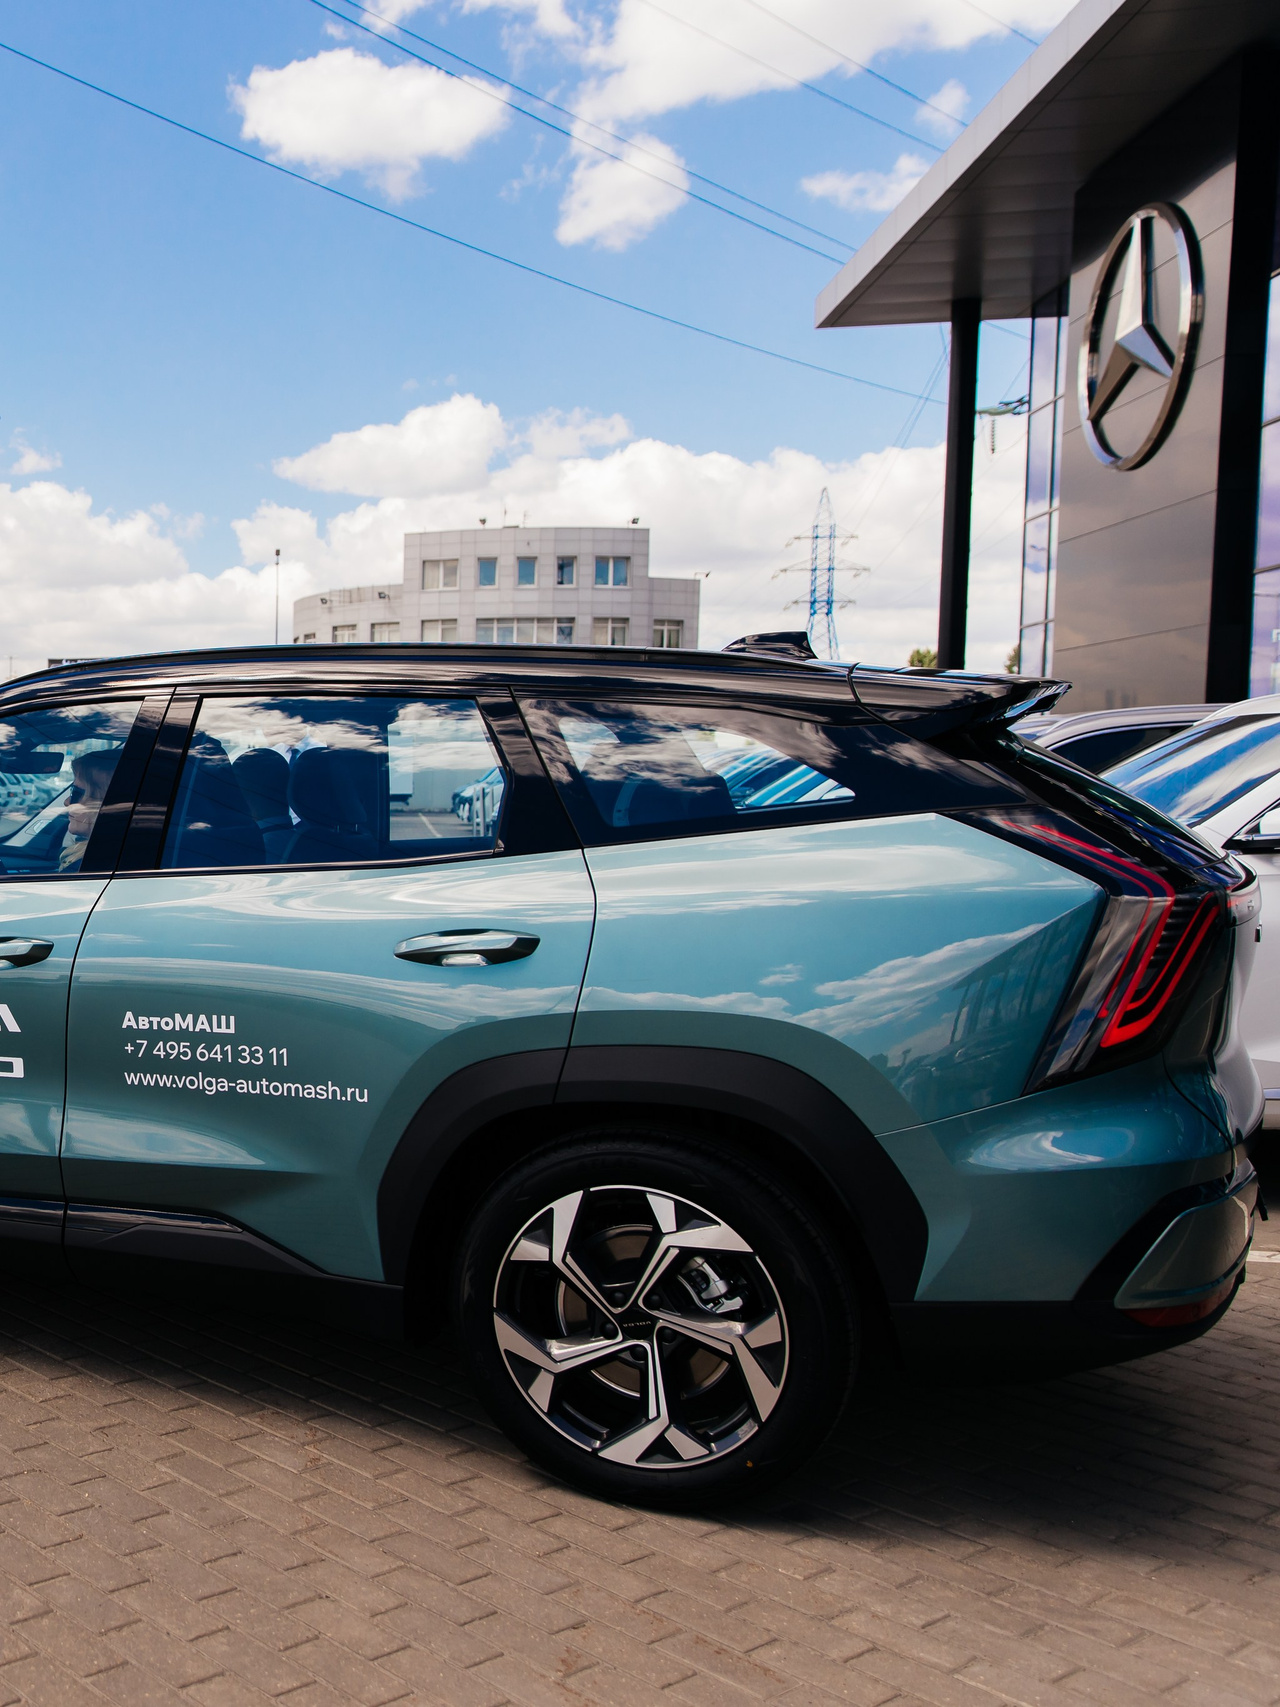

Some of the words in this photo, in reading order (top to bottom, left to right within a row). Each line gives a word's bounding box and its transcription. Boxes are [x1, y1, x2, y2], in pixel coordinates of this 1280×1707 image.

[122, 1011, 236, 1034] АвтоМАШ
[124, 1039, 148, 1058] +7
[152, 1041, 192, 1060] 495
[196, 1043, 232, 1063] 641
[237, 1045, 264, 1066] 33
[269, 1047, 289, 1066] 11
[124, 1072, 369, 1103] www.volga-automash.ru
